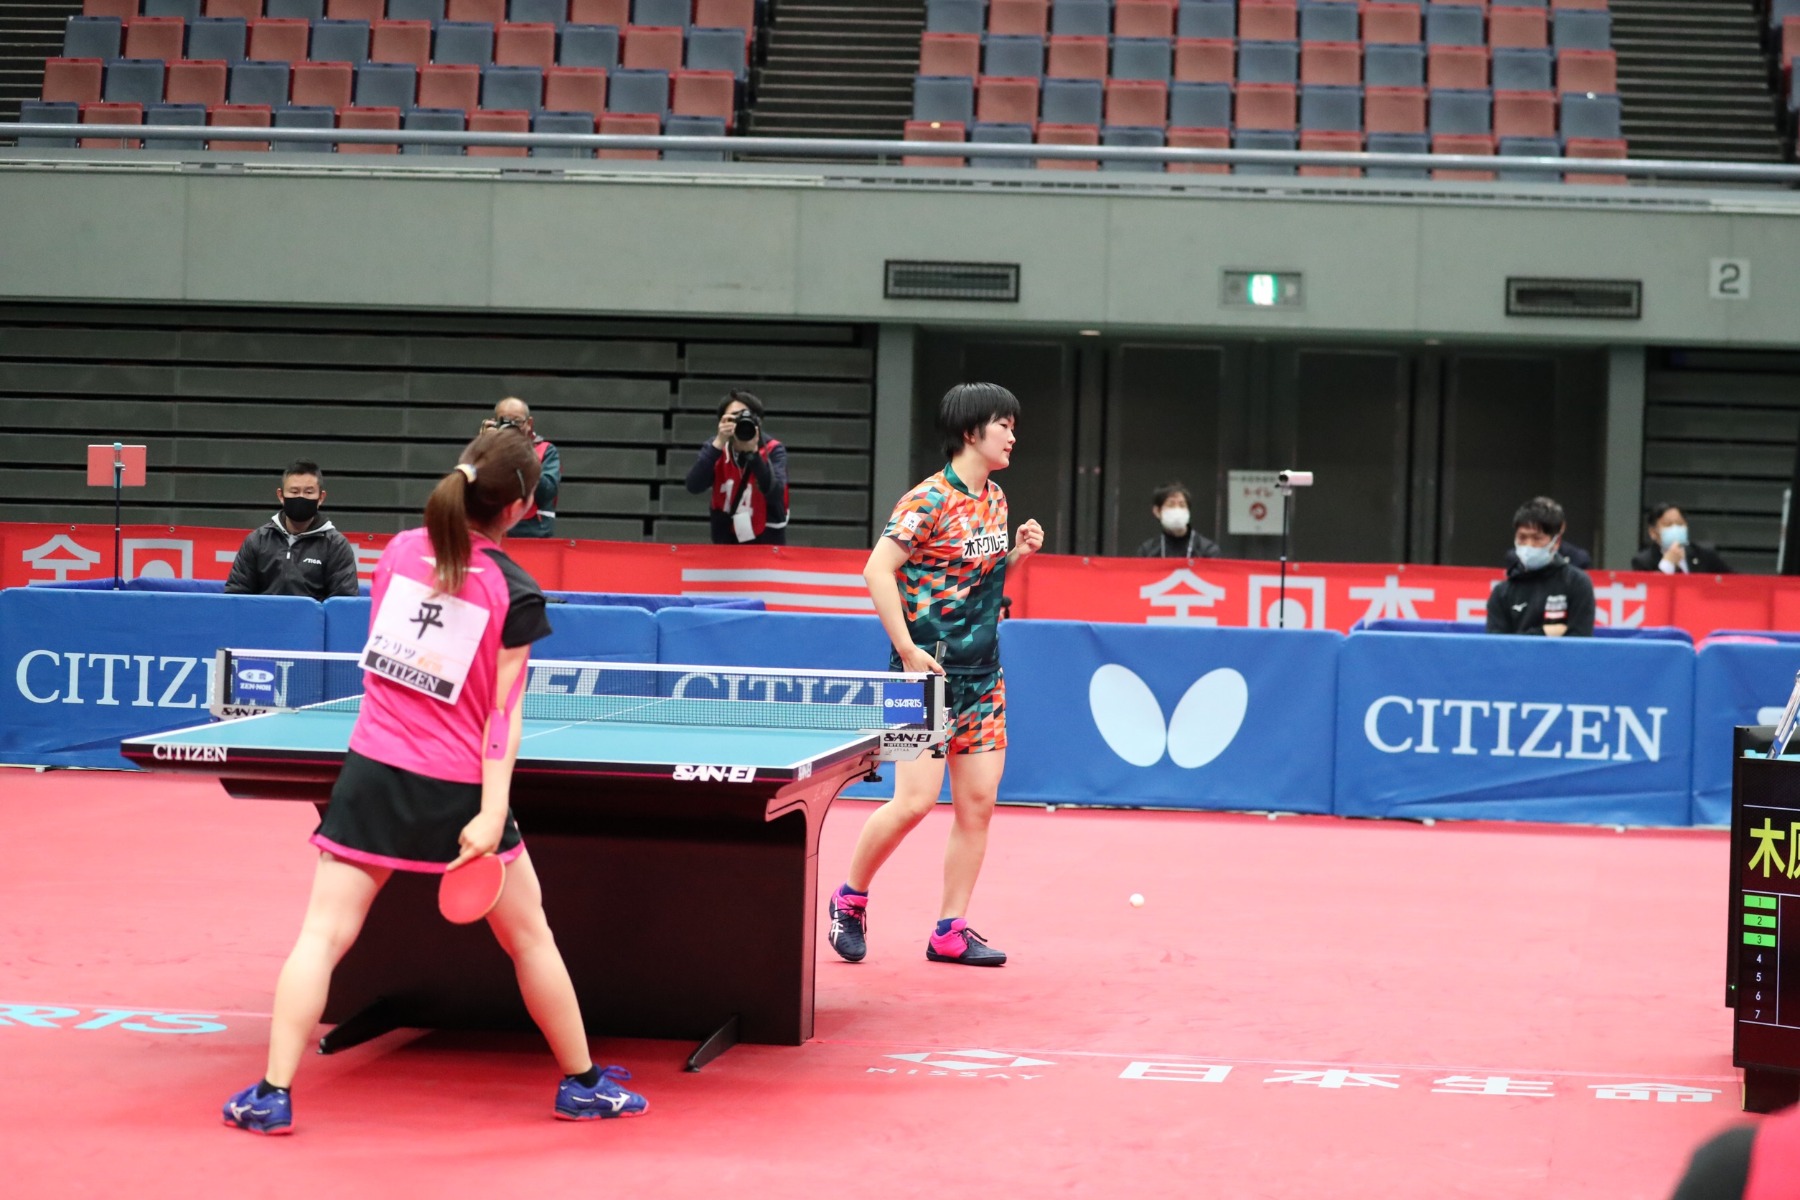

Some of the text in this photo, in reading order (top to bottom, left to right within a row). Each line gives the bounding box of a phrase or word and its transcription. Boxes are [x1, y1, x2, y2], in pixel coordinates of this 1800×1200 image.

[1719, 263, 1740, 294] 2
[409, 602, 444, 640] 平
[375, 655, 440, 693] CITIZEN
[894, 699, 923, 708] STARTS
[1364, 695, 1668, 762] CITIZEN
[153, 744, 228, 762] CITIZEN
[672, 764, 757, 783] SAN-EI
[866, 1067, 1044, 1080] NISSAY
[1118, 1061, 1722, 1103] 日本生命
